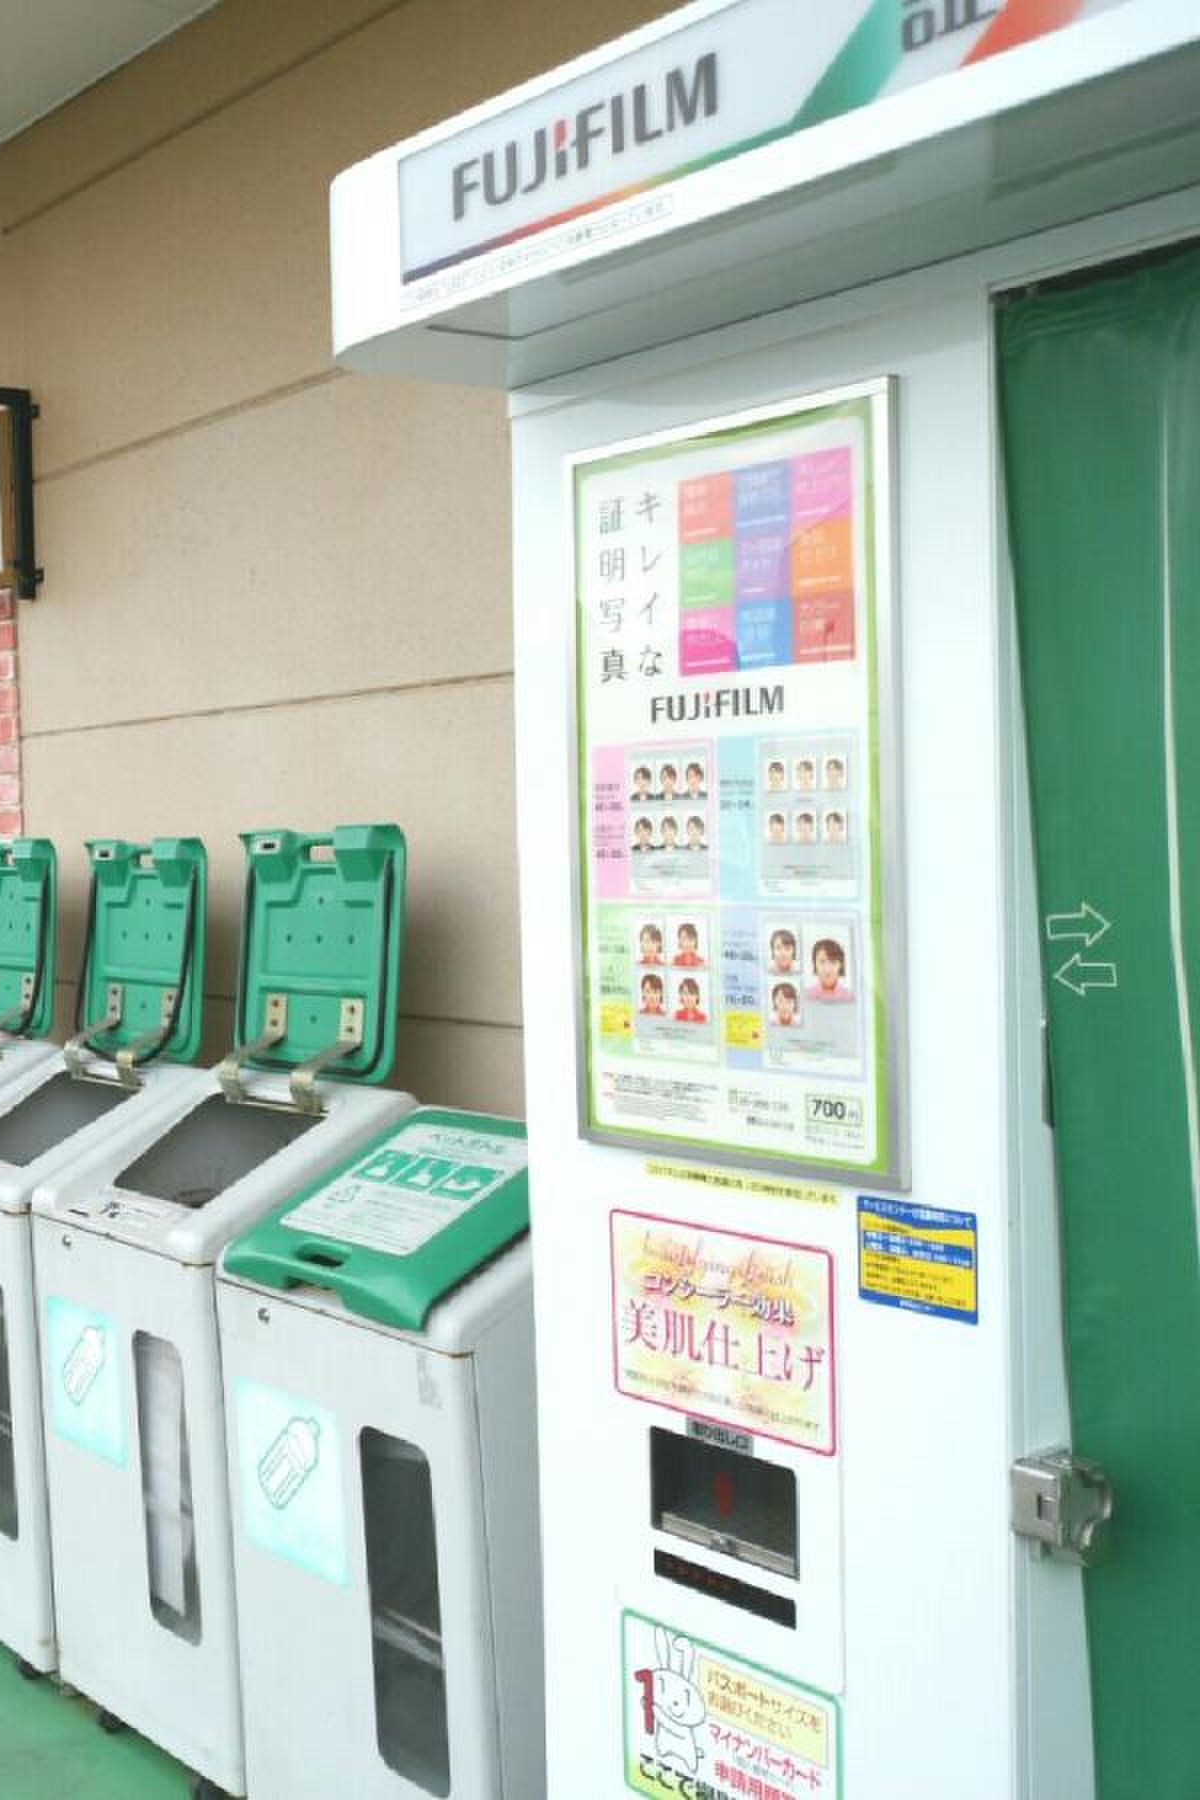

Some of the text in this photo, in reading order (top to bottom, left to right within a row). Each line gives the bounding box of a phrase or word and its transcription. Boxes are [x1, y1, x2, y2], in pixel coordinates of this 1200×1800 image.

[451, 51, 719, 221] FUJIFILM
[598, 494, 628, 684] 証明写真
[635, 491, 665, 678] キレイな
[650, 685, 785, 724] FUJIFILM
[811, 1098, 846, 1120] 700
[622, 1298, 826, 1392] 美肌仕上げ
[708, 1722, 822, 1790] マイナンバーカード
